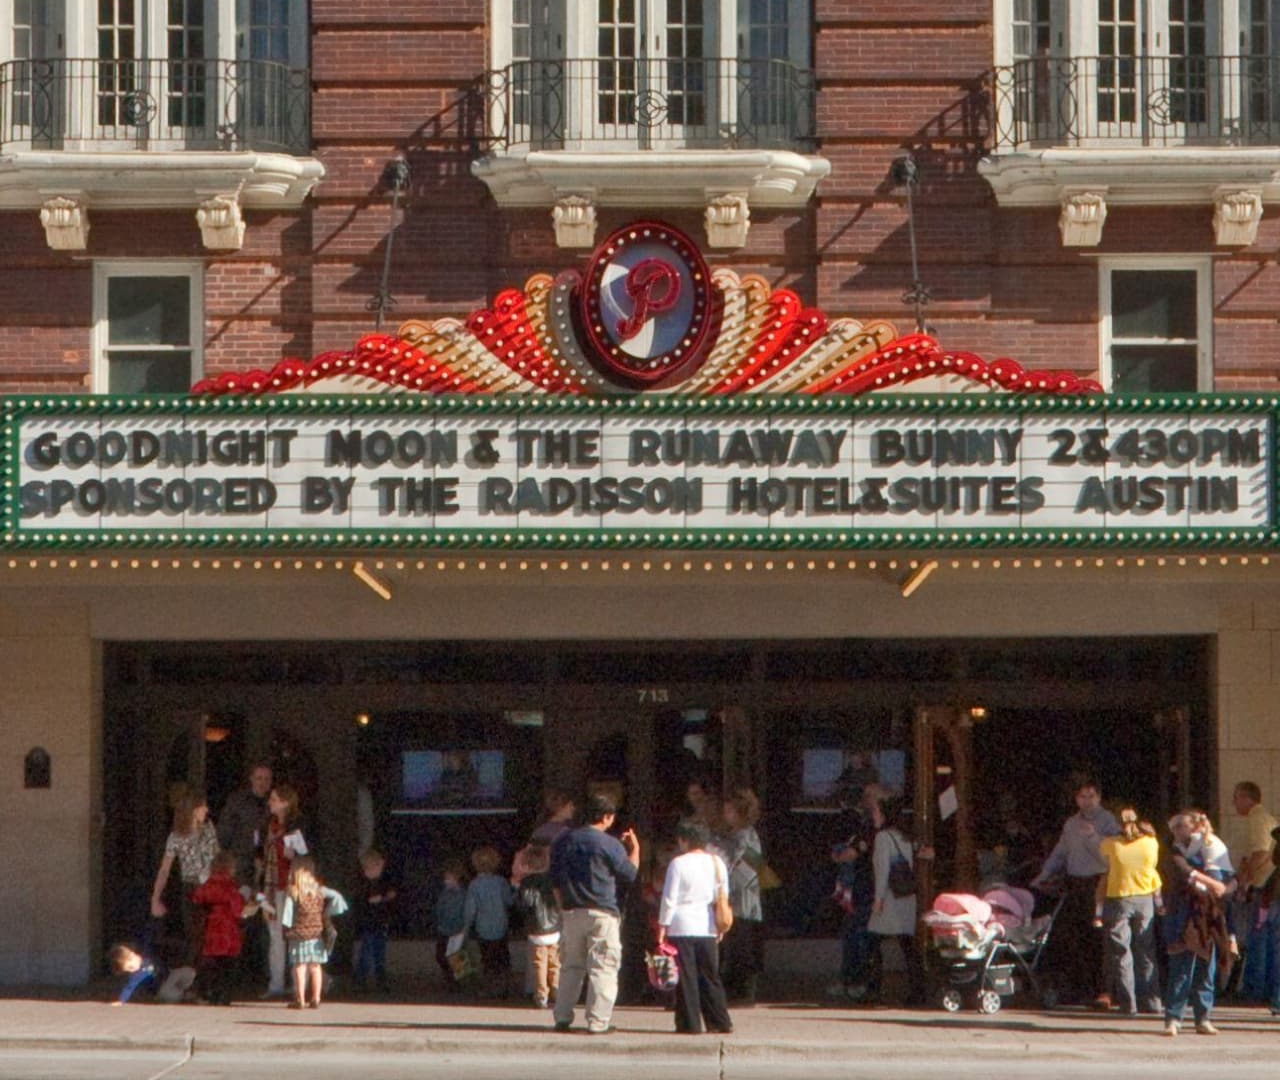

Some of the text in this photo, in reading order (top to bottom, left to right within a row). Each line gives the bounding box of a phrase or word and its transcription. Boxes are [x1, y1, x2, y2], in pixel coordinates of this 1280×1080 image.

[25, 429, 298, 469] GOODNIGHT
[325, 429, 458, 469] MOON
[465, 429, 500, 469] &
[509, 429, 600, 469] THE
[628, 429, 848, 468] RUNAWAY
[872, 429, 1024, 467] BUNNY
[20, 477, 278, 518] SPONSORED
[301, 477, 356, 516] BY
[370, 477, 460, 517] THE
[478, 477, 704, 517] RADISSON
[1074, 476, 1238, 516] AUSTIN
